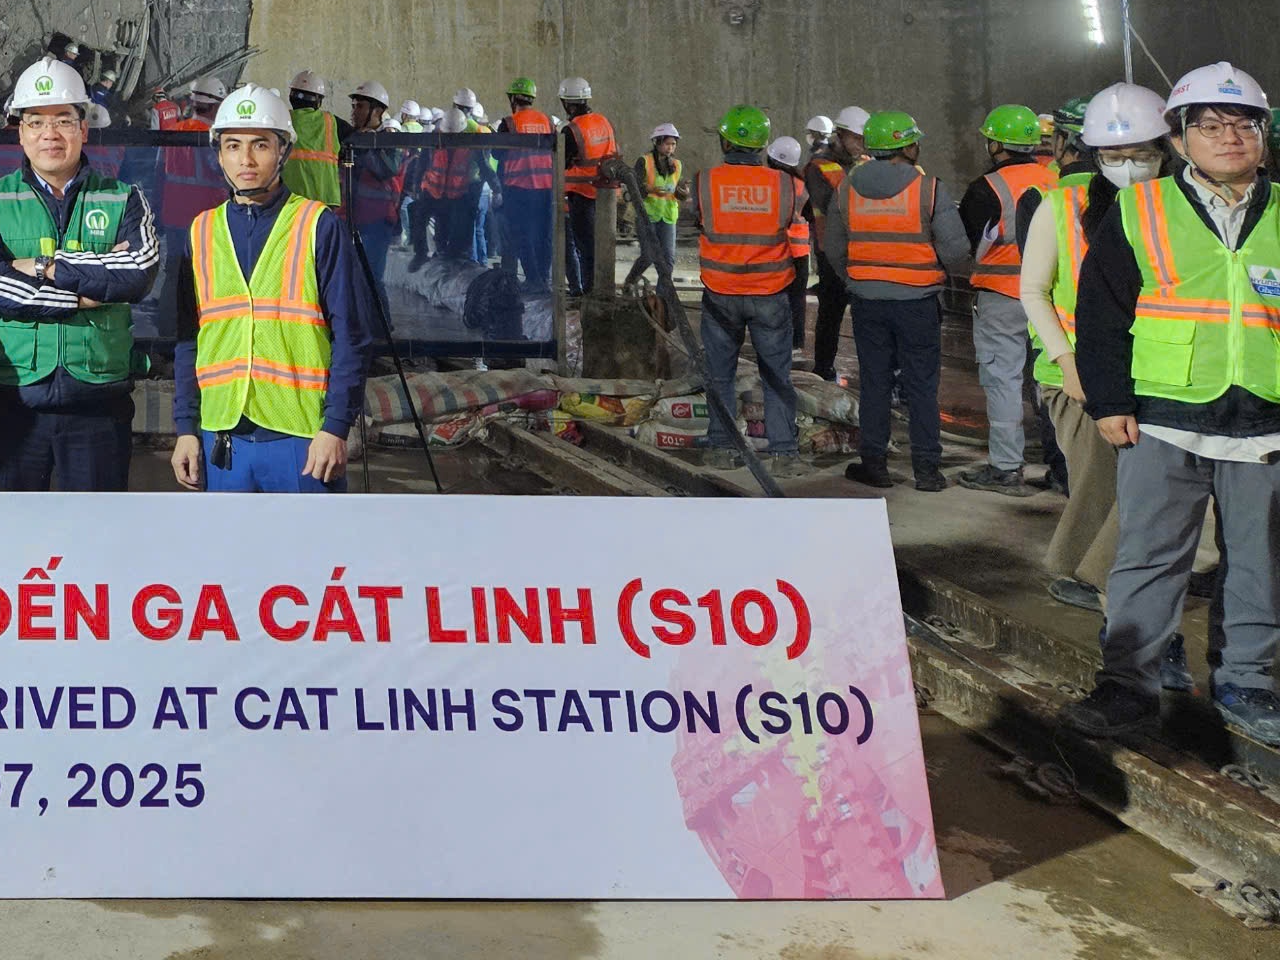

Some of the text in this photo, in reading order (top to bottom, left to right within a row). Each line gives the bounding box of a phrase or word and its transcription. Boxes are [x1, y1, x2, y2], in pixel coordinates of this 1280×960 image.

[722, 186, 770, 205] FRU
[132, 584, 238, 640] GA
[258, 567, 403, 642] CÁT
[426, 586, 595, 645] LINH
[618, 578, 813, 659] (S10)
[152, 686, 218, 730] AT
[234, 686, 338, 731] CAT
[354, 687, 477, 732] LINH
[491, 688, 721, 734] STATION
[735, 683, 874, 746] (S10)
[67, 762, 205, 809] 2025
